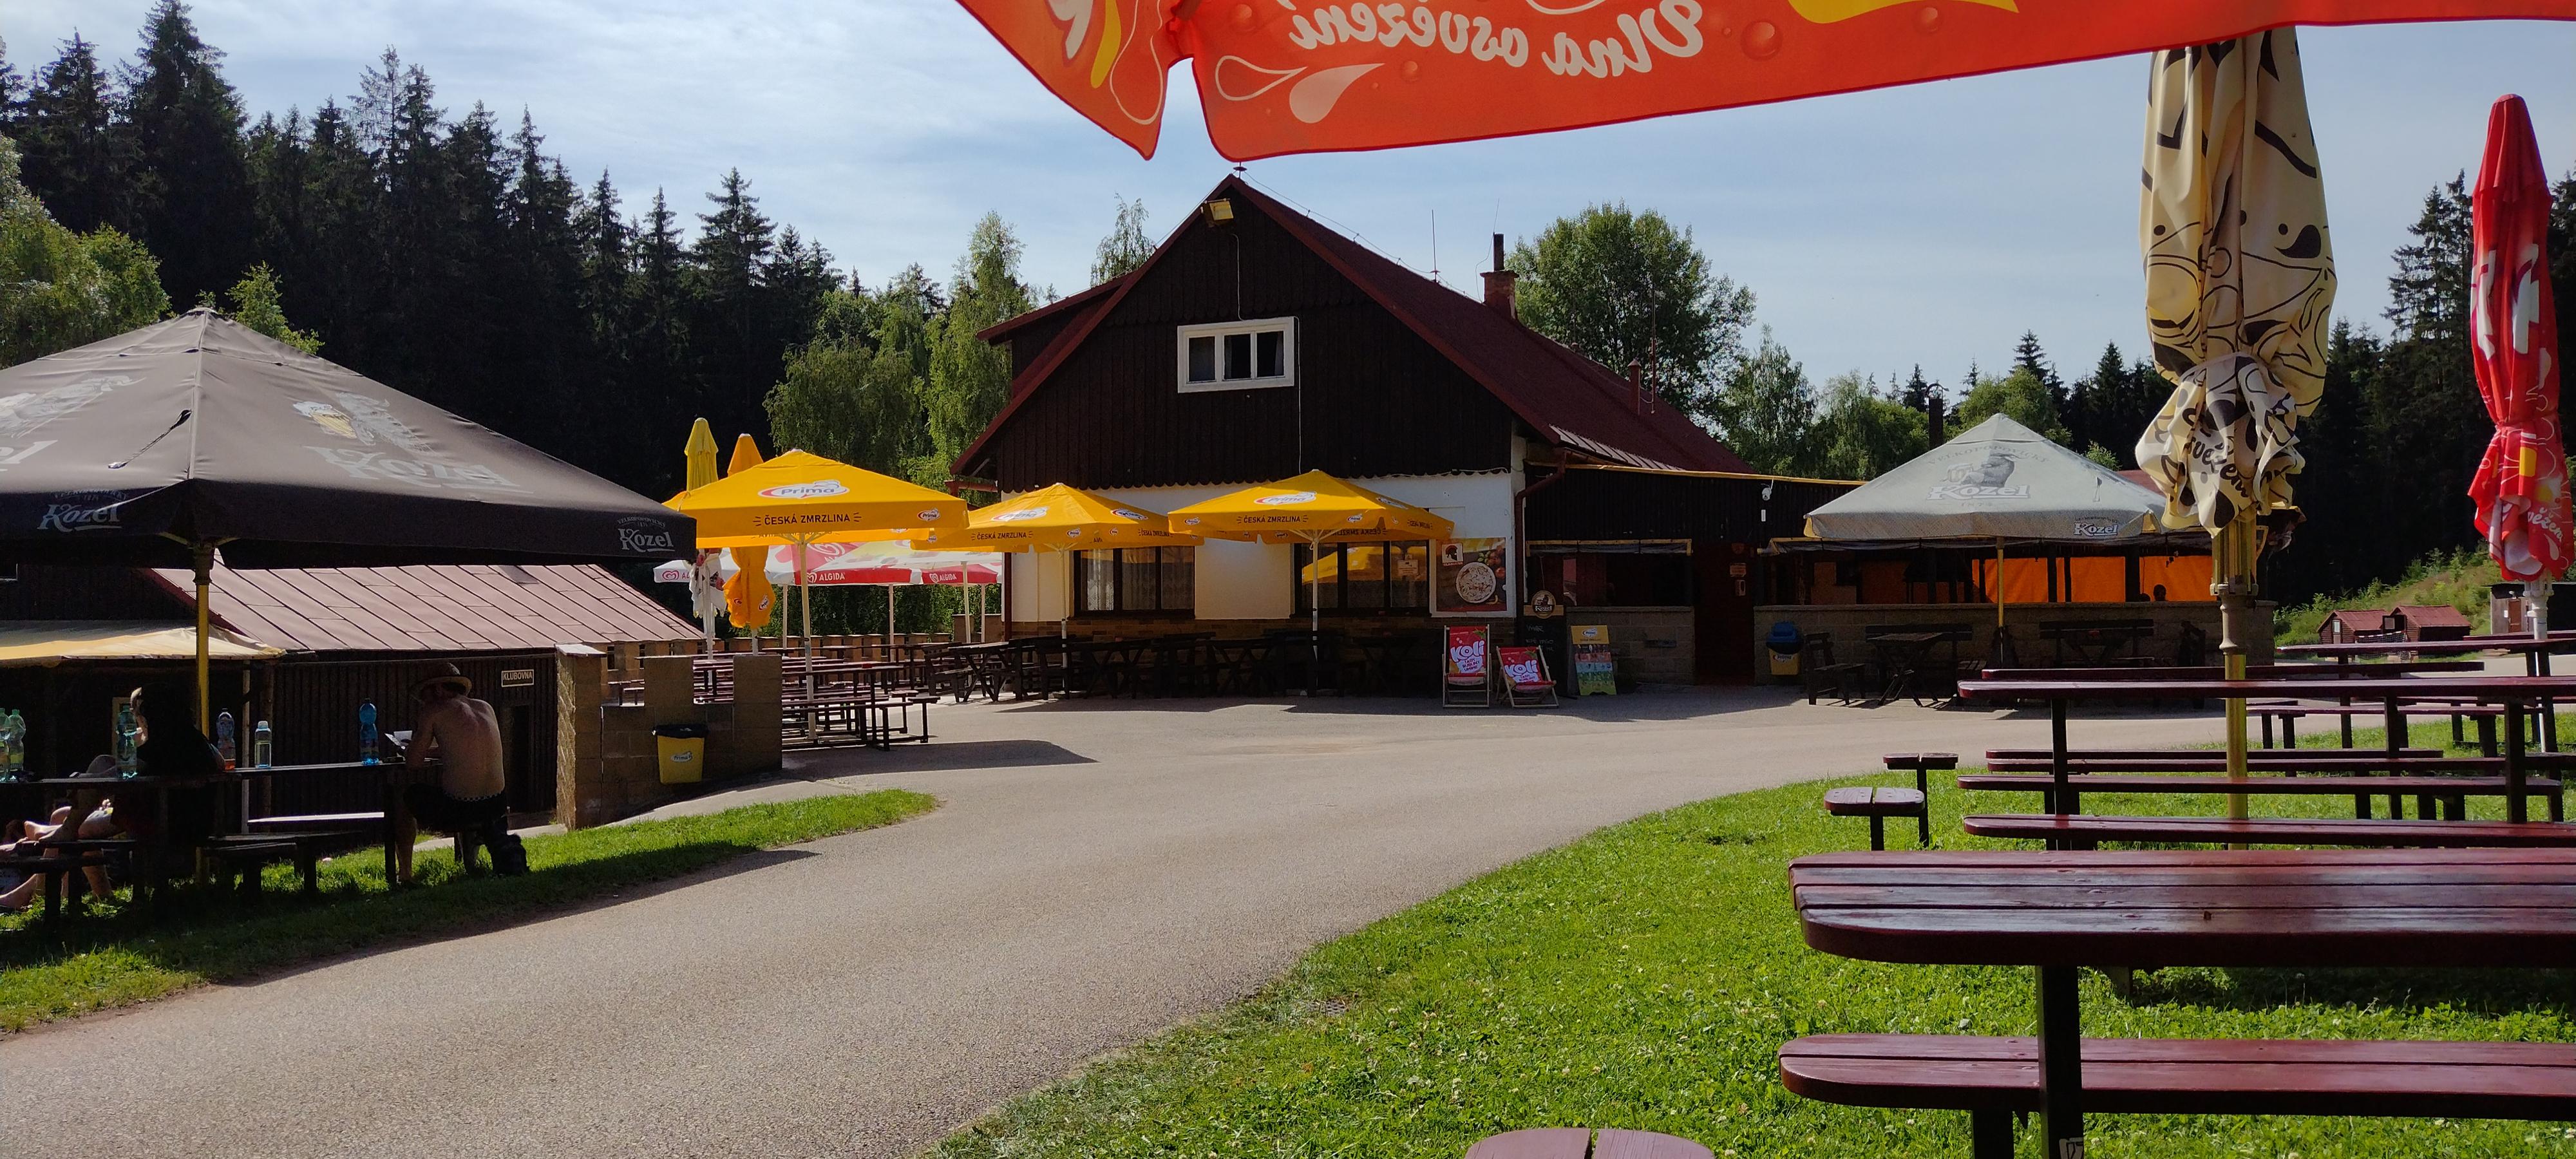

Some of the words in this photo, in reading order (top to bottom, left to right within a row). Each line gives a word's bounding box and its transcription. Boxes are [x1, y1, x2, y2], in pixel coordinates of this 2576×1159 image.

[1926, 484, 2031, 500] Kozel
[37, 504, 121, 532] Kozel
[764, 514, 797, 525] ČESKÁ
[801, 513, 851, 523] ZMRZLINA
[1244, 515, 1265, 523] ČESKÁ
[2074, 522, 2118, 537] Kozel
[618, 528, 674, 552] Kozel
[977, 531, 996, 540] ČESKÁ
[819, 572, 845, 581] ALGIDA
[940, 573, 957, 581] ALGIDA
[503, 672, 533, 681] KLUBOVNA
